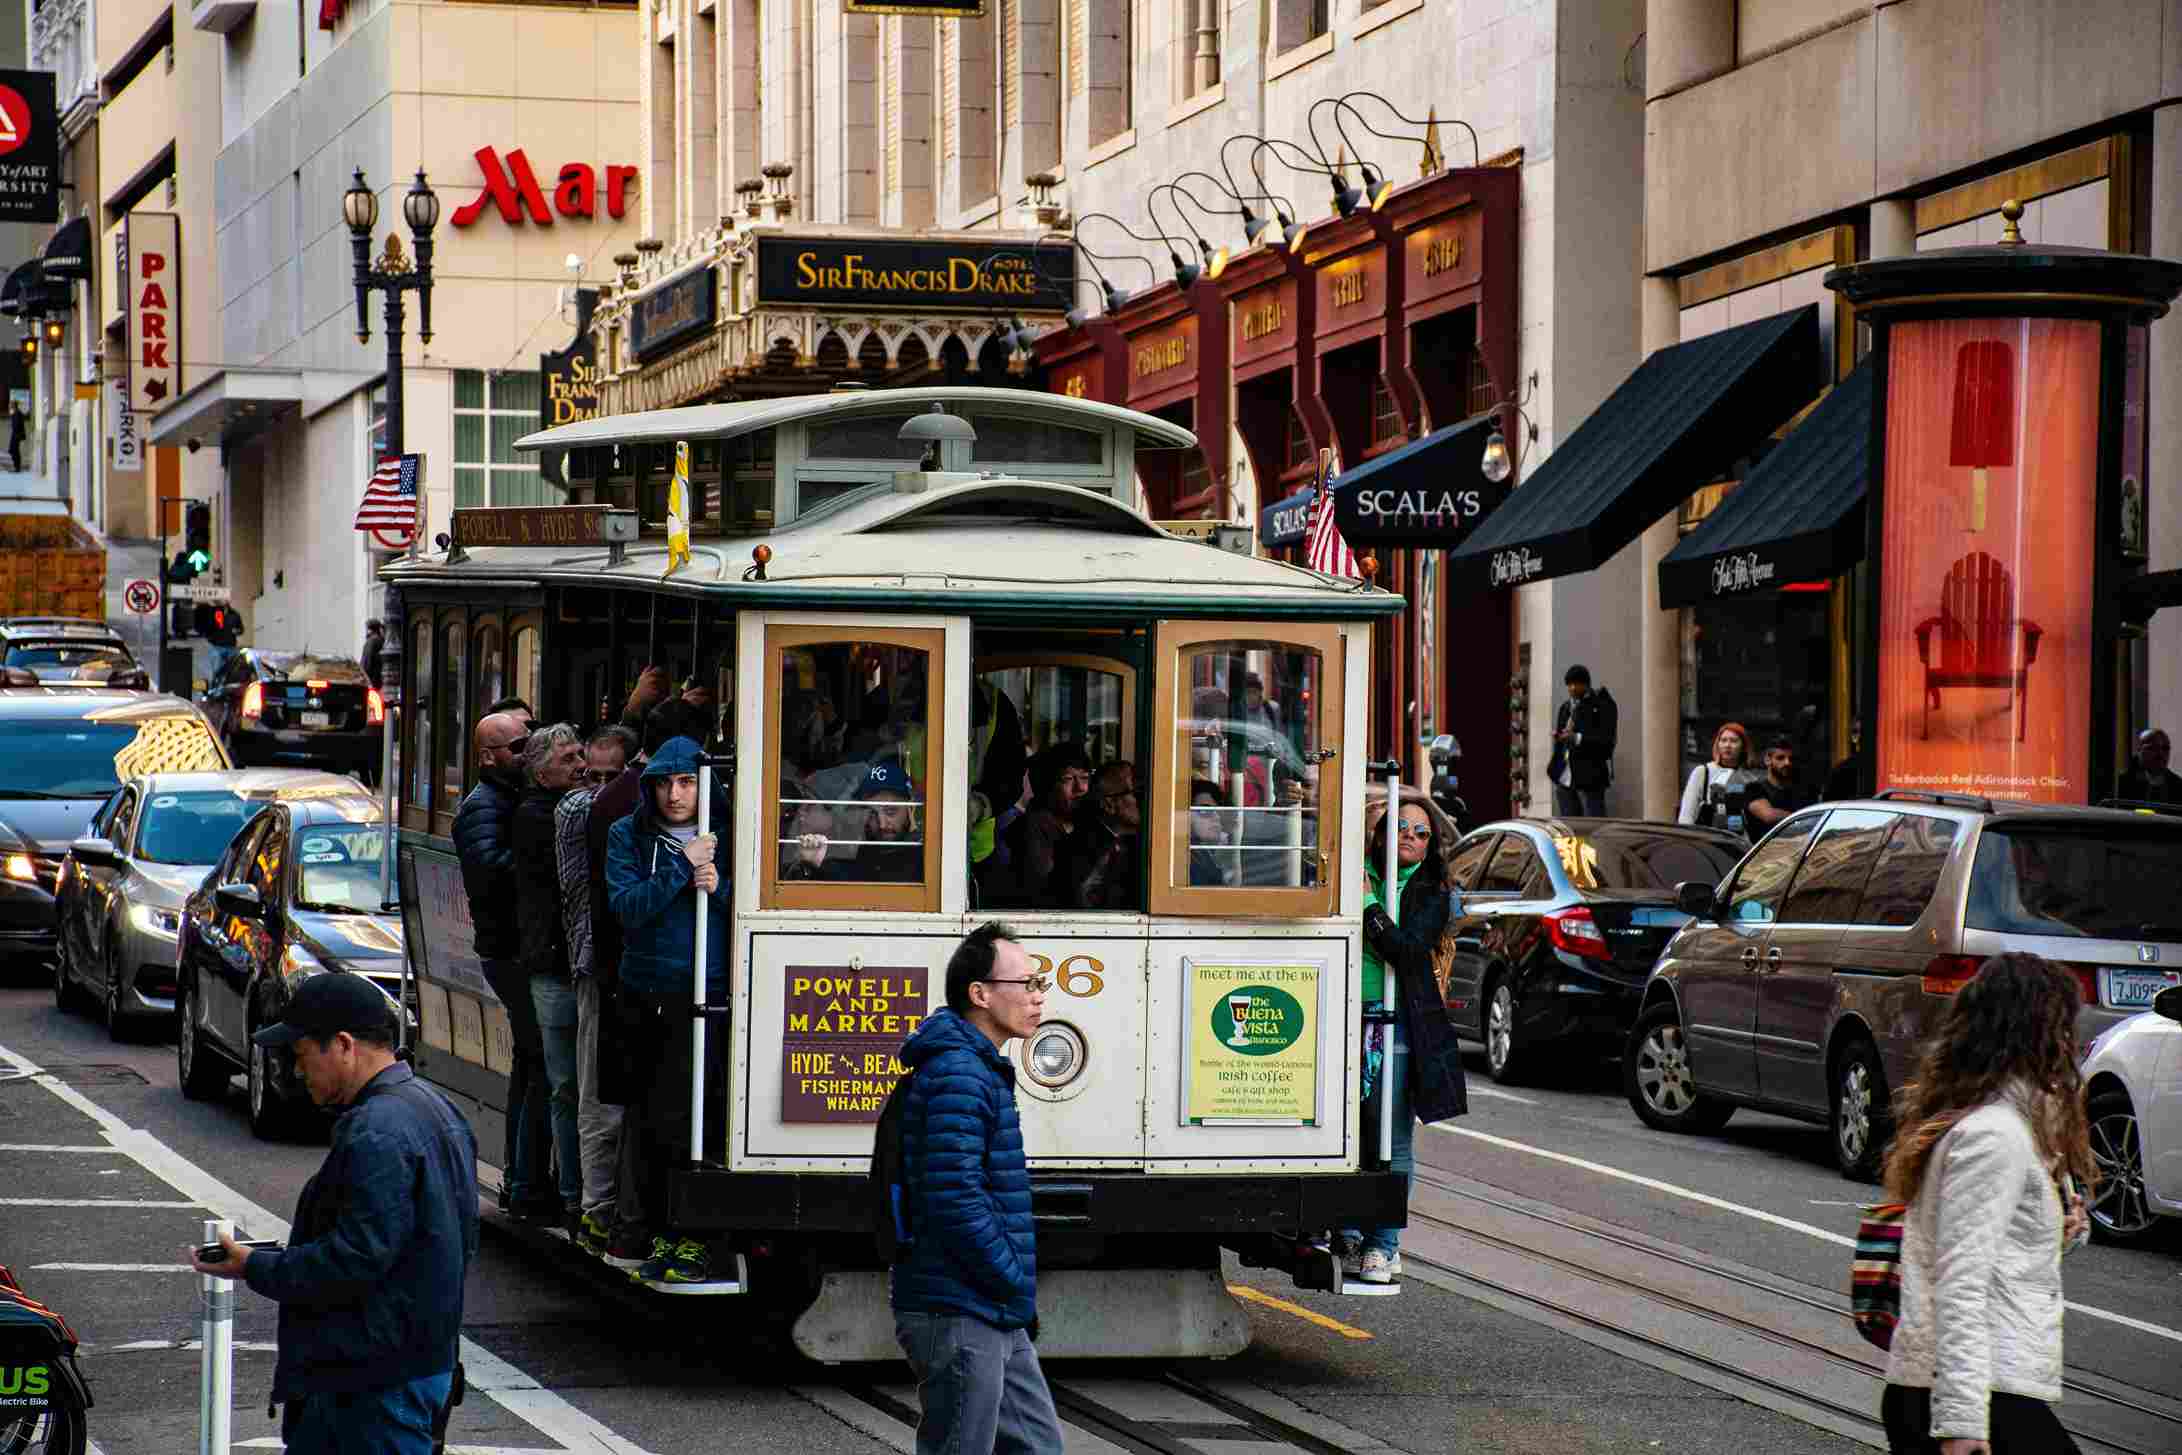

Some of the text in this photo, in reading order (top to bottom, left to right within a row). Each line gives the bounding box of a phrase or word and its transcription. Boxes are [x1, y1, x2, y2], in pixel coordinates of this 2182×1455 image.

[450, 145, 638, 224] Mar
[140, 252, 169, 368] PARK
[1357, 490, 1480, 516] SCALA'S
[871, 766, 887, 781] KC
[1200, 969, 1233, 981] meet
[1236, 970, 1256, 981] me
[793, 977, 921, 997] POWELL
[826, 998, 889, 1012] AND
[788, 1014, 922, 1033] MARKET
[791, 1054, 834, 1074] HYDE
[826, 1096, 884, 1111] WHARF
[0, 1366, 49, 1395] US
